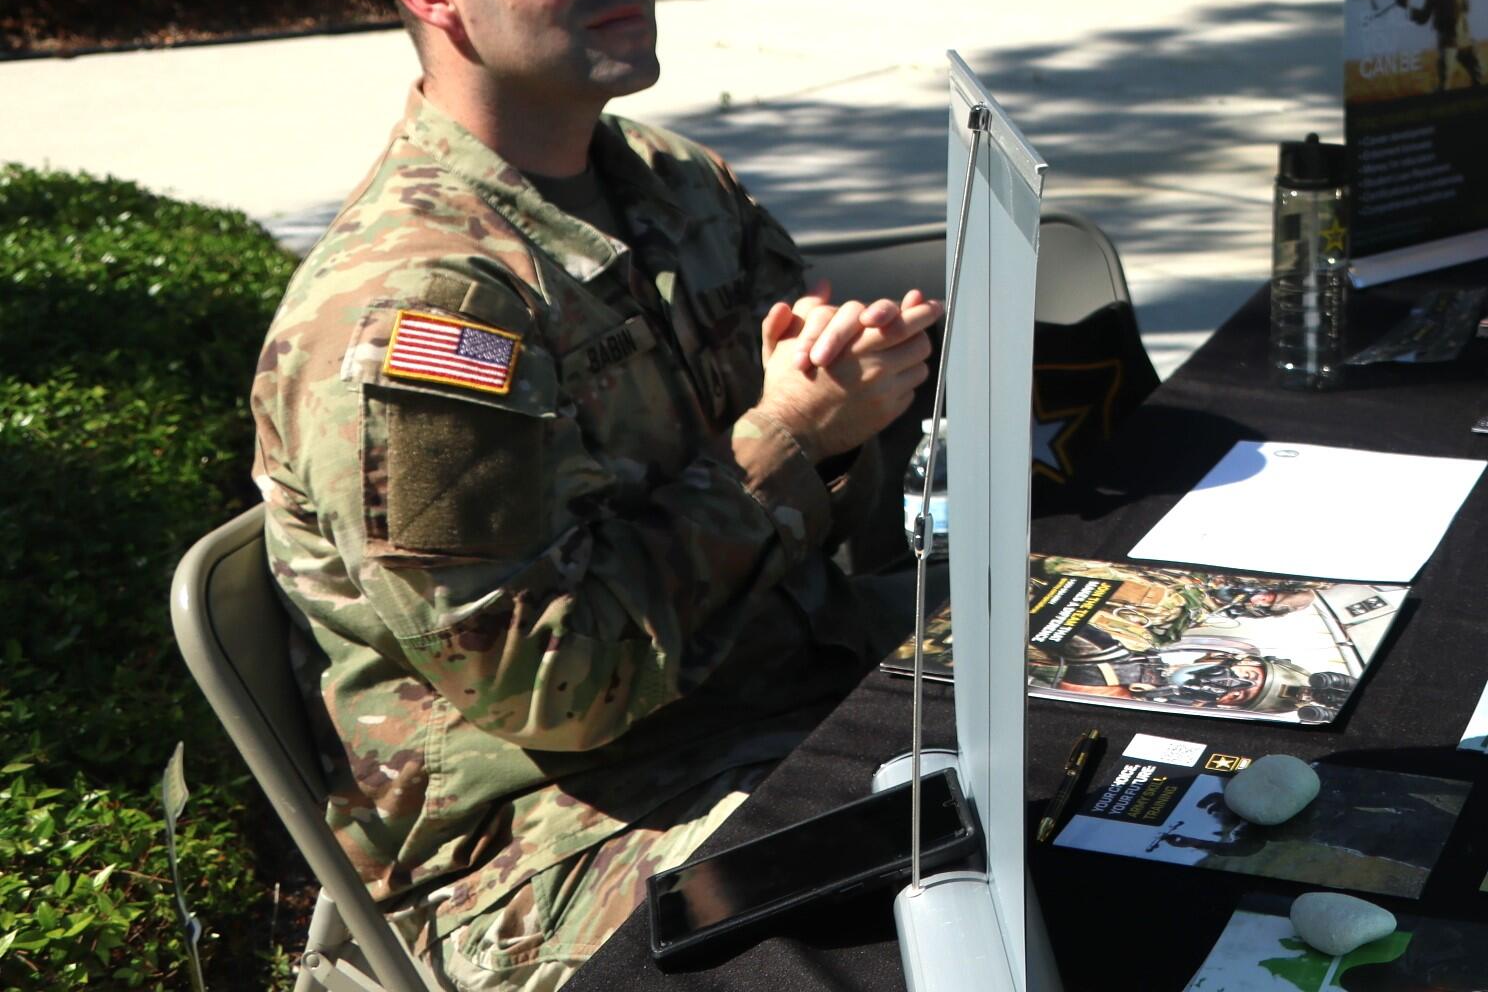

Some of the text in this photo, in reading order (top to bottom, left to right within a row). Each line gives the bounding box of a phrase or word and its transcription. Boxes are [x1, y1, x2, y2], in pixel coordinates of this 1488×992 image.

[1090, 582, 1112, 597] JOIN
[1080, 596, 1100, 610] THE
[1063, 609, 1088, 627] TEAM
[1048, 626, 1072, 642] THAT
[1091, 792, 1118, 812] YOUR
[1109, 794, 1134, 815] YOUR
[1127, 796, 1148, 819] ARMY
